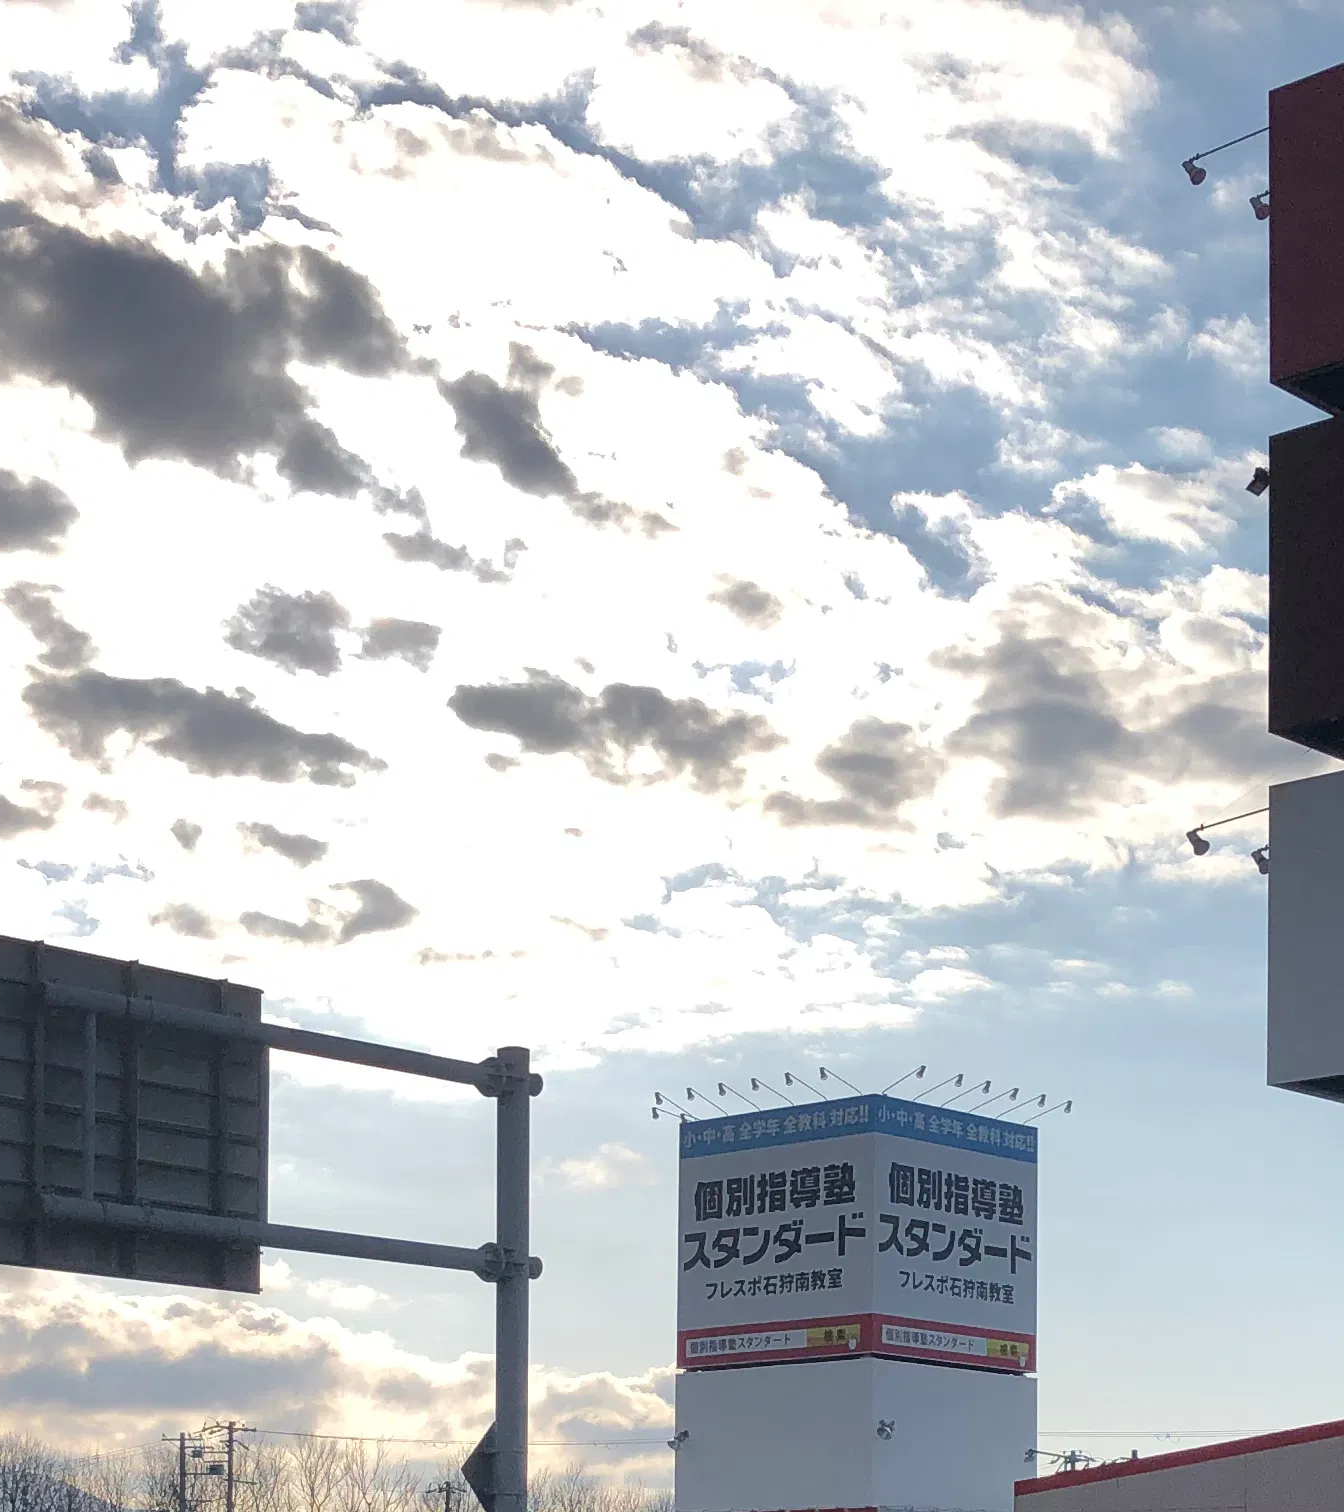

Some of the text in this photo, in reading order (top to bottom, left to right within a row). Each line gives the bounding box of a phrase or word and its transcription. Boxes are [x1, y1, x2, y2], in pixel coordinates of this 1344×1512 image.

[693, 1161, 857, 1222] 個別指導塾
[888, 1161, 1025, 1226] 個別指導塾
[683, 1211, 867, 1272] スタンダード
[878, 1212, 1033, 1275] スタンダード
[705, 1267, 843, 1300] フレスポ石狩南教室
[899, 1269, 1015, 1304] フレスポ石狩南教室
